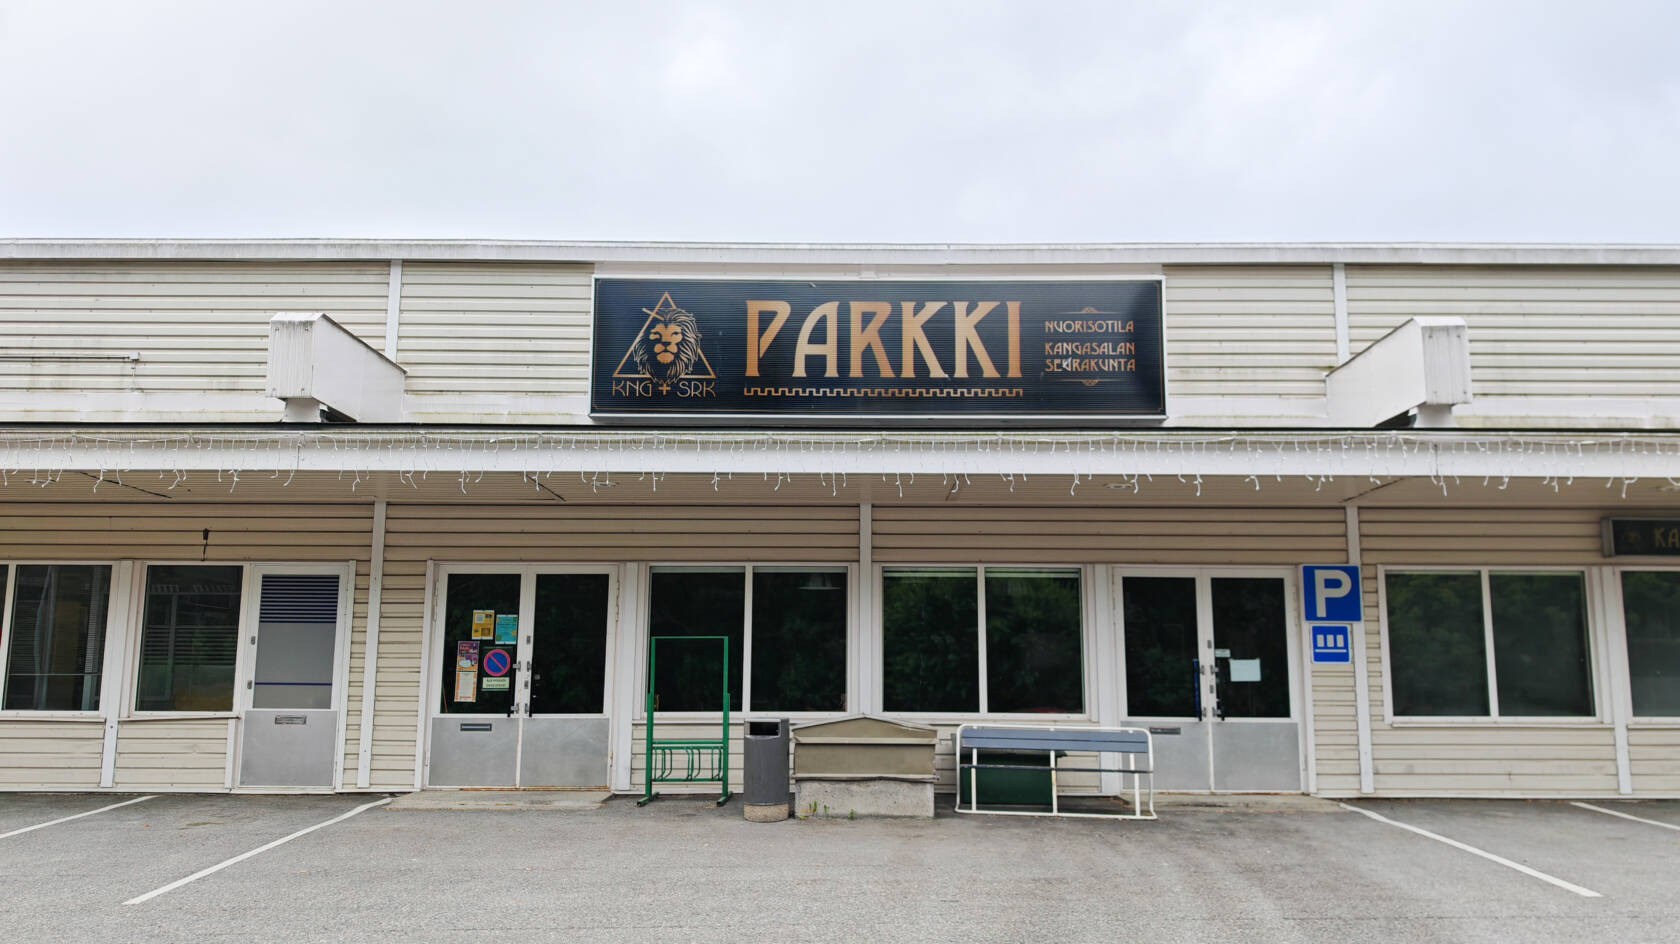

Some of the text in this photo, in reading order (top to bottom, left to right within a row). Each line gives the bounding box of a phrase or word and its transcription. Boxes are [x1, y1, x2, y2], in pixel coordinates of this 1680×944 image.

[1044, 320, 1136, 333] NUORISOTILA
[745, 300, 1023, 379] PARKKI
[1044, 342, 1136, 355] KANGASALAN
[1044, 358, 1136, 372] SEURAKUNTA
[612, 380, 717, 397] KNG SRK
[1314, 569, 1352, 618] P
